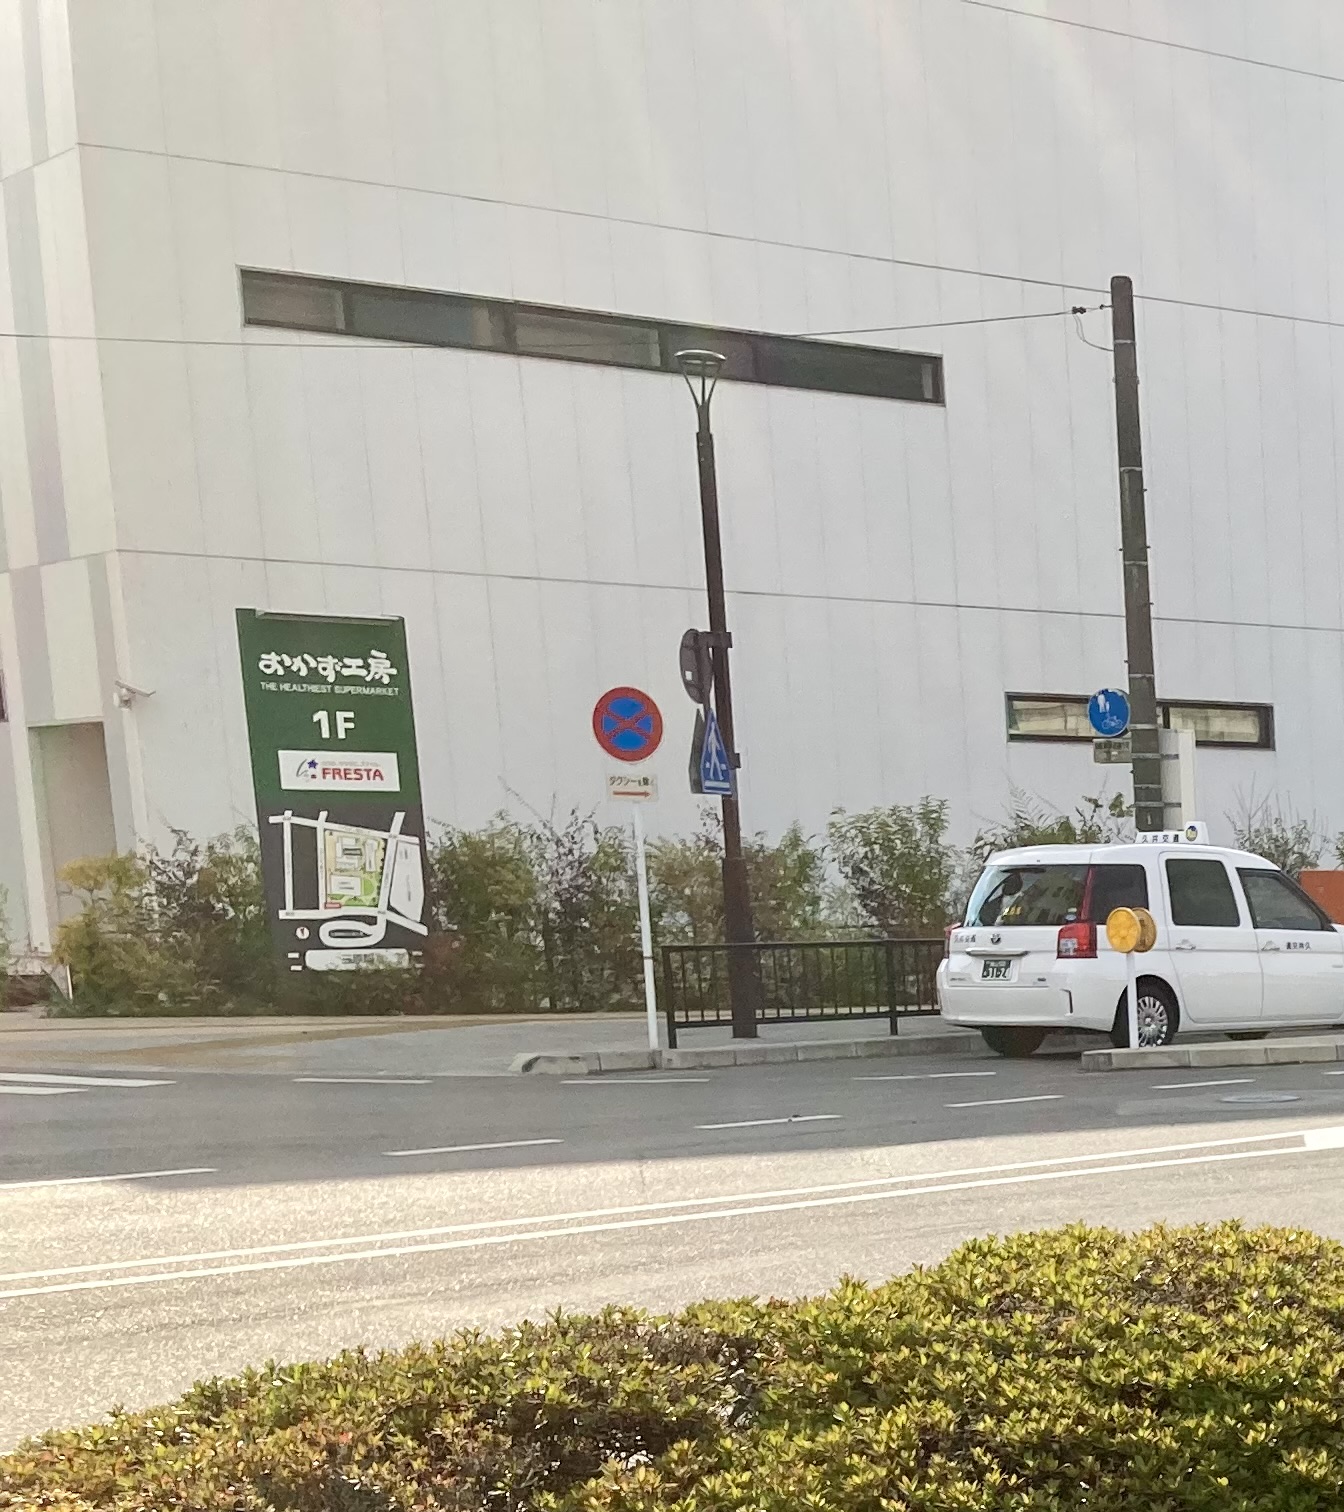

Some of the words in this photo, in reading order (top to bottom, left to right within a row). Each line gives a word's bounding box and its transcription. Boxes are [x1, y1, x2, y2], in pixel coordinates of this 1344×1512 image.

[258, 649, 398, 685] おかず工房
[260, 681, 279, 692] THE
[279, 682, 332, 694] HEALTHIEST
[333, 685, 399, 697] SUPERMARKET
[312, 710, 355, 739] 1F
[321, 767, 385, 782] FRESTA
